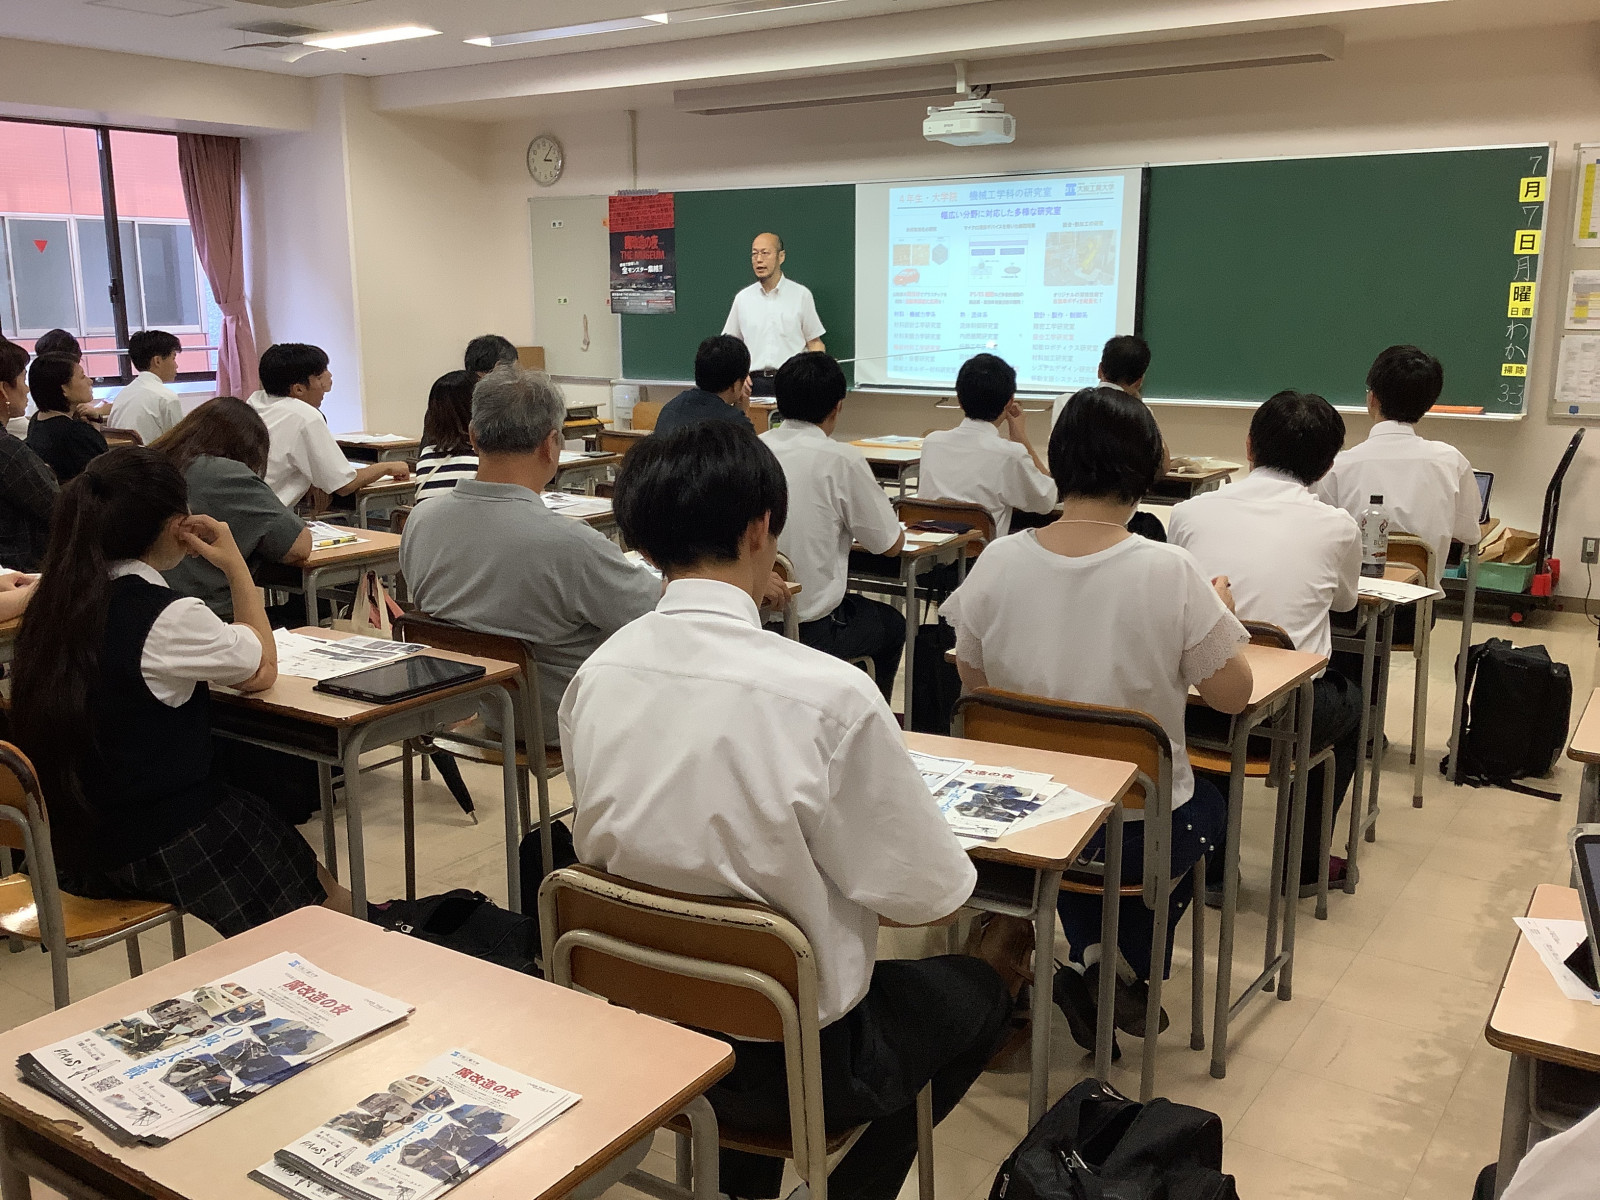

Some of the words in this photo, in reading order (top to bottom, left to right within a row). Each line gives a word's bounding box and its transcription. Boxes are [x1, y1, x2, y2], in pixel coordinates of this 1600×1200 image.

[1524, 180, 1541, 199] 月
[1519, 233, 1536, 252] 日
[1513, 285, 1532, 303] 曜
[1510, 306, 1532, 316] 日直
[1503, 365, 1525, 375] 掃除
[283, 979, 353, 1016] 魔改造の夜
[455, 1067, 522, 1099] 魔改造の夜
